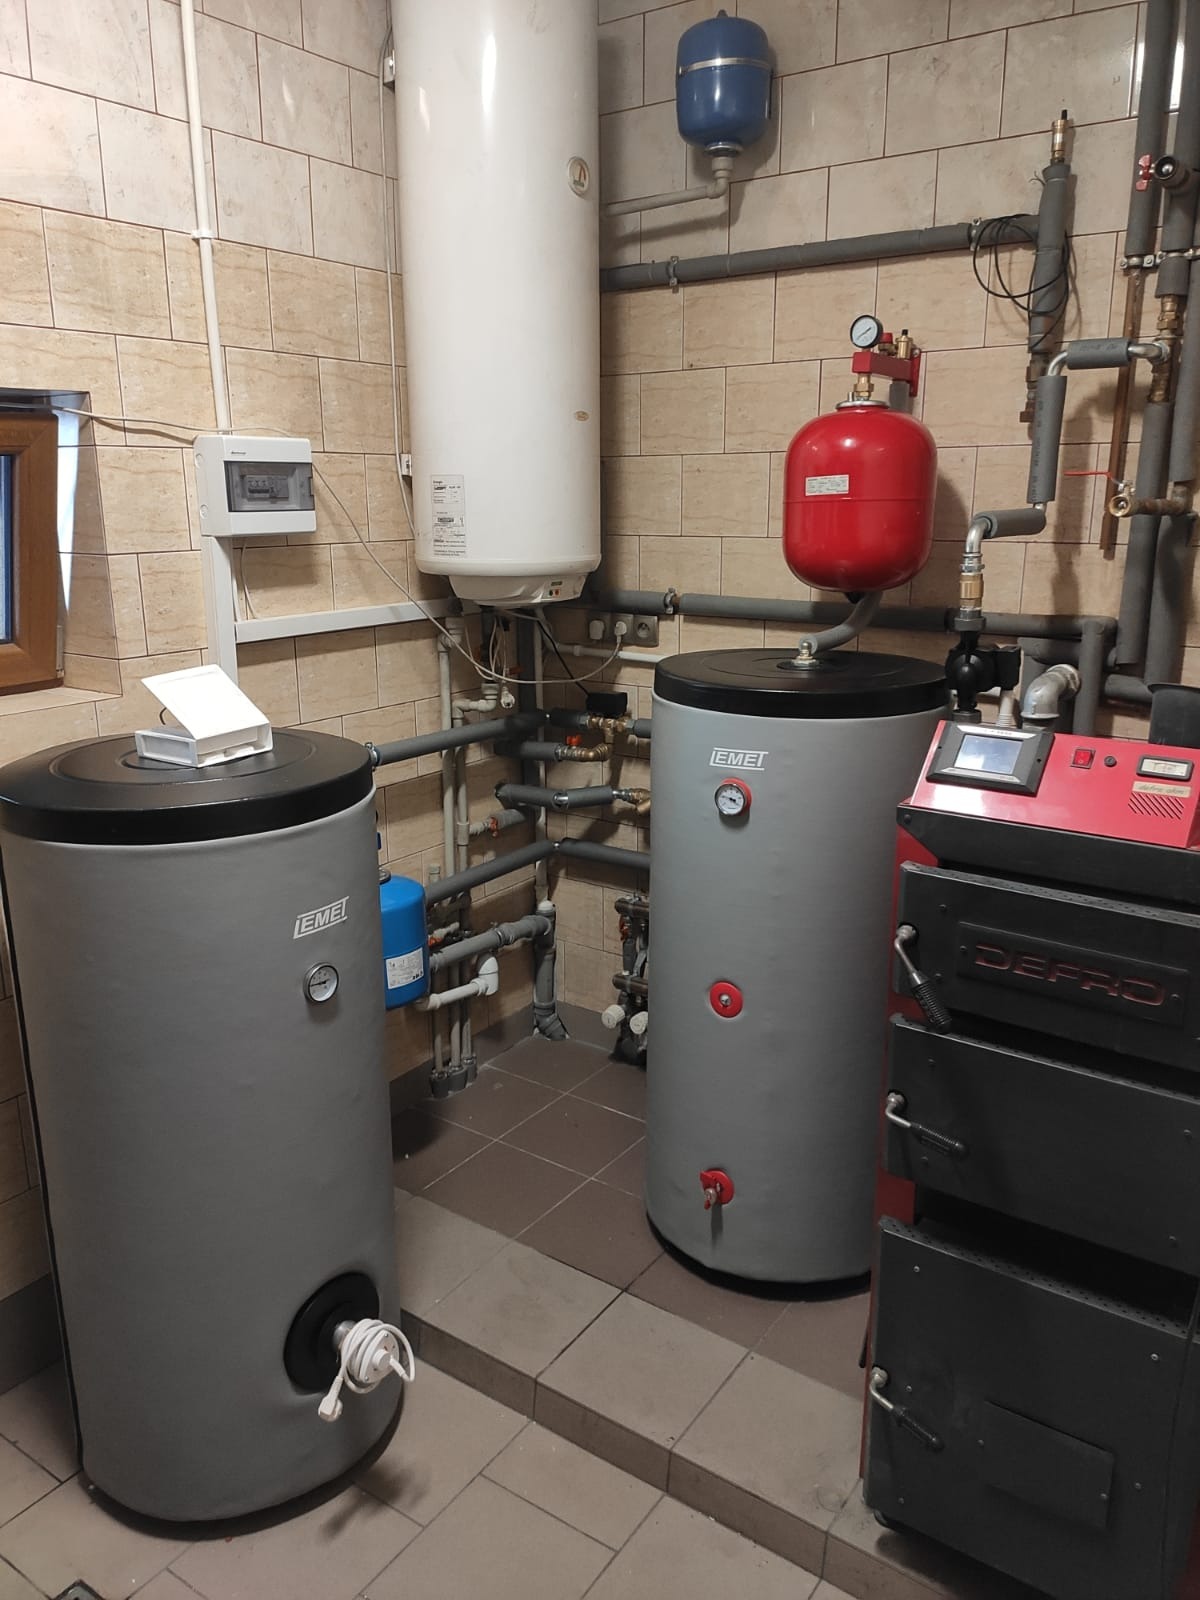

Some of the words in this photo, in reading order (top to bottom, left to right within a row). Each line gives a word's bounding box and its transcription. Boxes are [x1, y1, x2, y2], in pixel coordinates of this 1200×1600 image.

[709, 747, 769, 771] LEMET
[293, 895, 350, 940] LEMET
[974, 943, 1166, 1006] DEFRO
